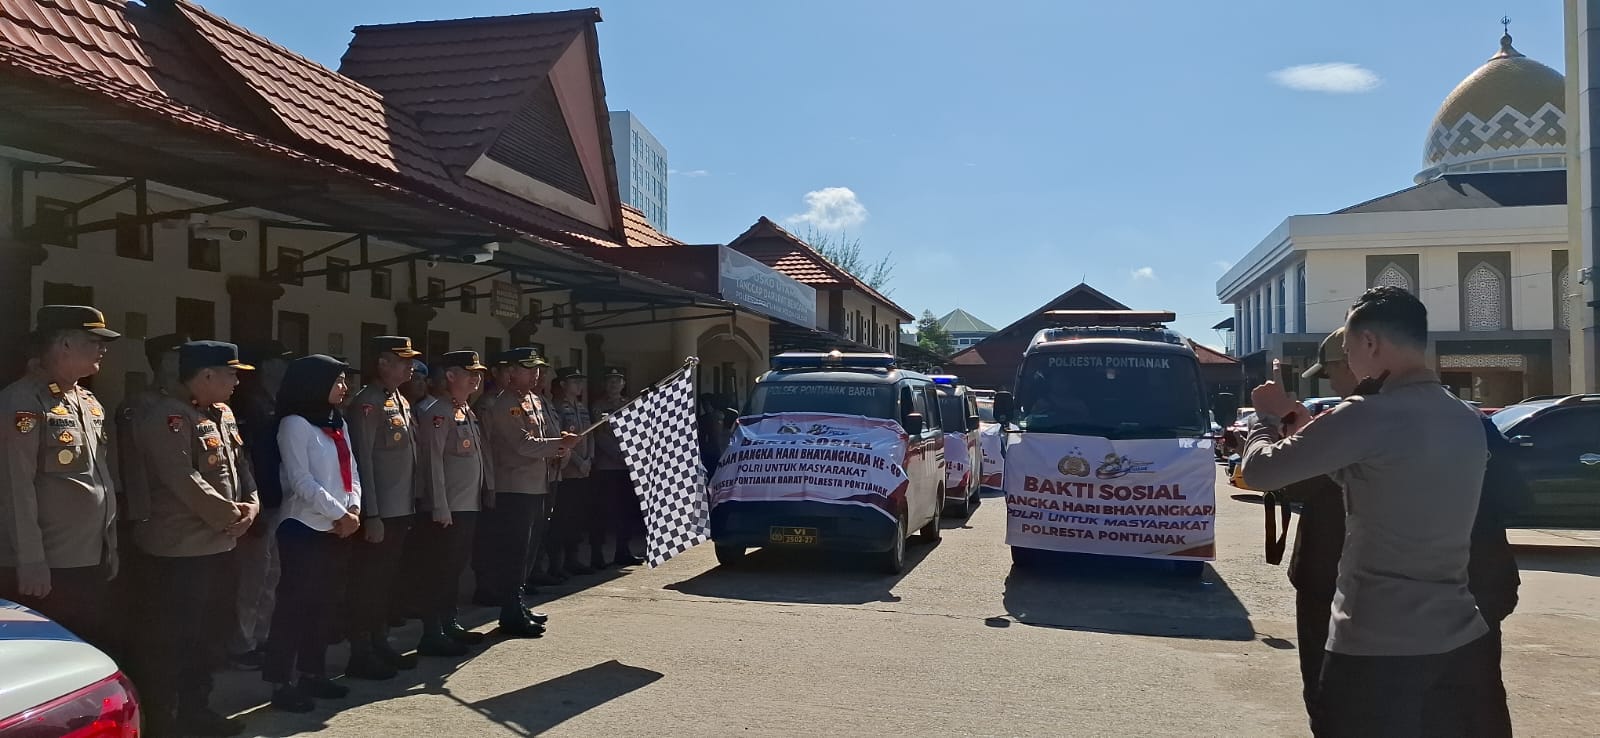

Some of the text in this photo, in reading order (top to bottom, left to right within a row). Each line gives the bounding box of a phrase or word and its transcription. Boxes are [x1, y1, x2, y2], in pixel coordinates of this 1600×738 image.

[1049, 357, 1171, 369] POLRESTA PONTIANAK
[800, 386, 846, 397] PONTIANAK
[848, 386, 877, 397] BARAT
[719, 451, 738, 468] ALAM
[738, 446, 774, 462] RANGKA
[775, 446, 799, 460] HARI
[801, 447, 871, 467] BHAYANGKARA
[872, 455, 886, 471] KE
[737, 461, 867, 478] POLRI UNTUK MASYARAKAT
[734, 475, 776, 487] PONTIANAK
[777, 474, 802, 485] BARAT
[803, 475, 843, 488] POLRESTA
[844, 479, 888, 496] PONTIANAK
[1023, 476, 1187, 501] BAKTI SOSIAL
[1005, 493, 1216, 517] ANGKA HARI BHAYANGKARA
[1007, 508, 1209, 531] POLRI UNTUK MASYARAKAT
[1021, 523, 1187, 545] POLRESTA PONTIANAK
